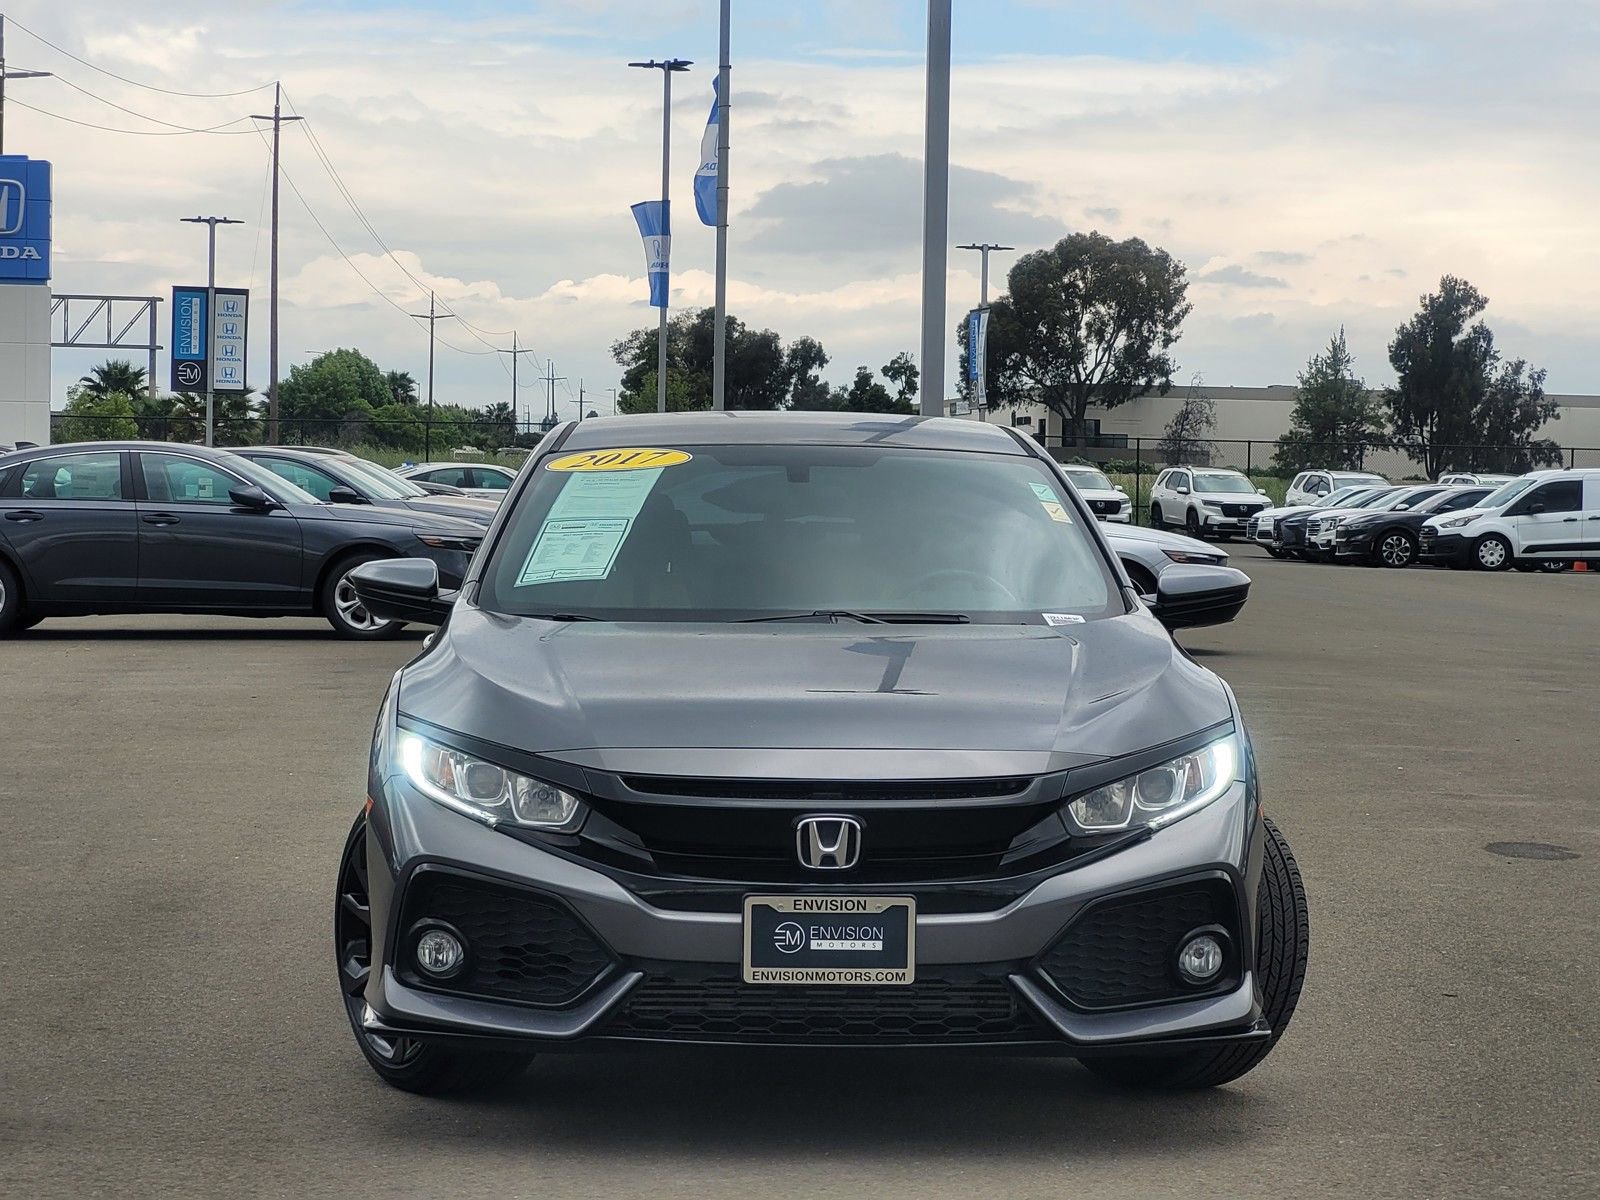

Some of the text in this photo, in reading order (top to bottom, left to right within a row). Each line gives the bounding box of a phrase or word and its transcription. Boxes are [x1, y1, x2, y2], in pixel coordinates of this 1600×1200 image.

[180, 297, 192, 354] ENVISION
[568, 451, 667, 468] 2017
[793, 899, 868, 911] ENVISION
[810, 926, 884, 940] ENVISION
[816, 941, 877, 949] MOTORS
[752, 970, 907, 982] ENVISIONMOTORS.COM
